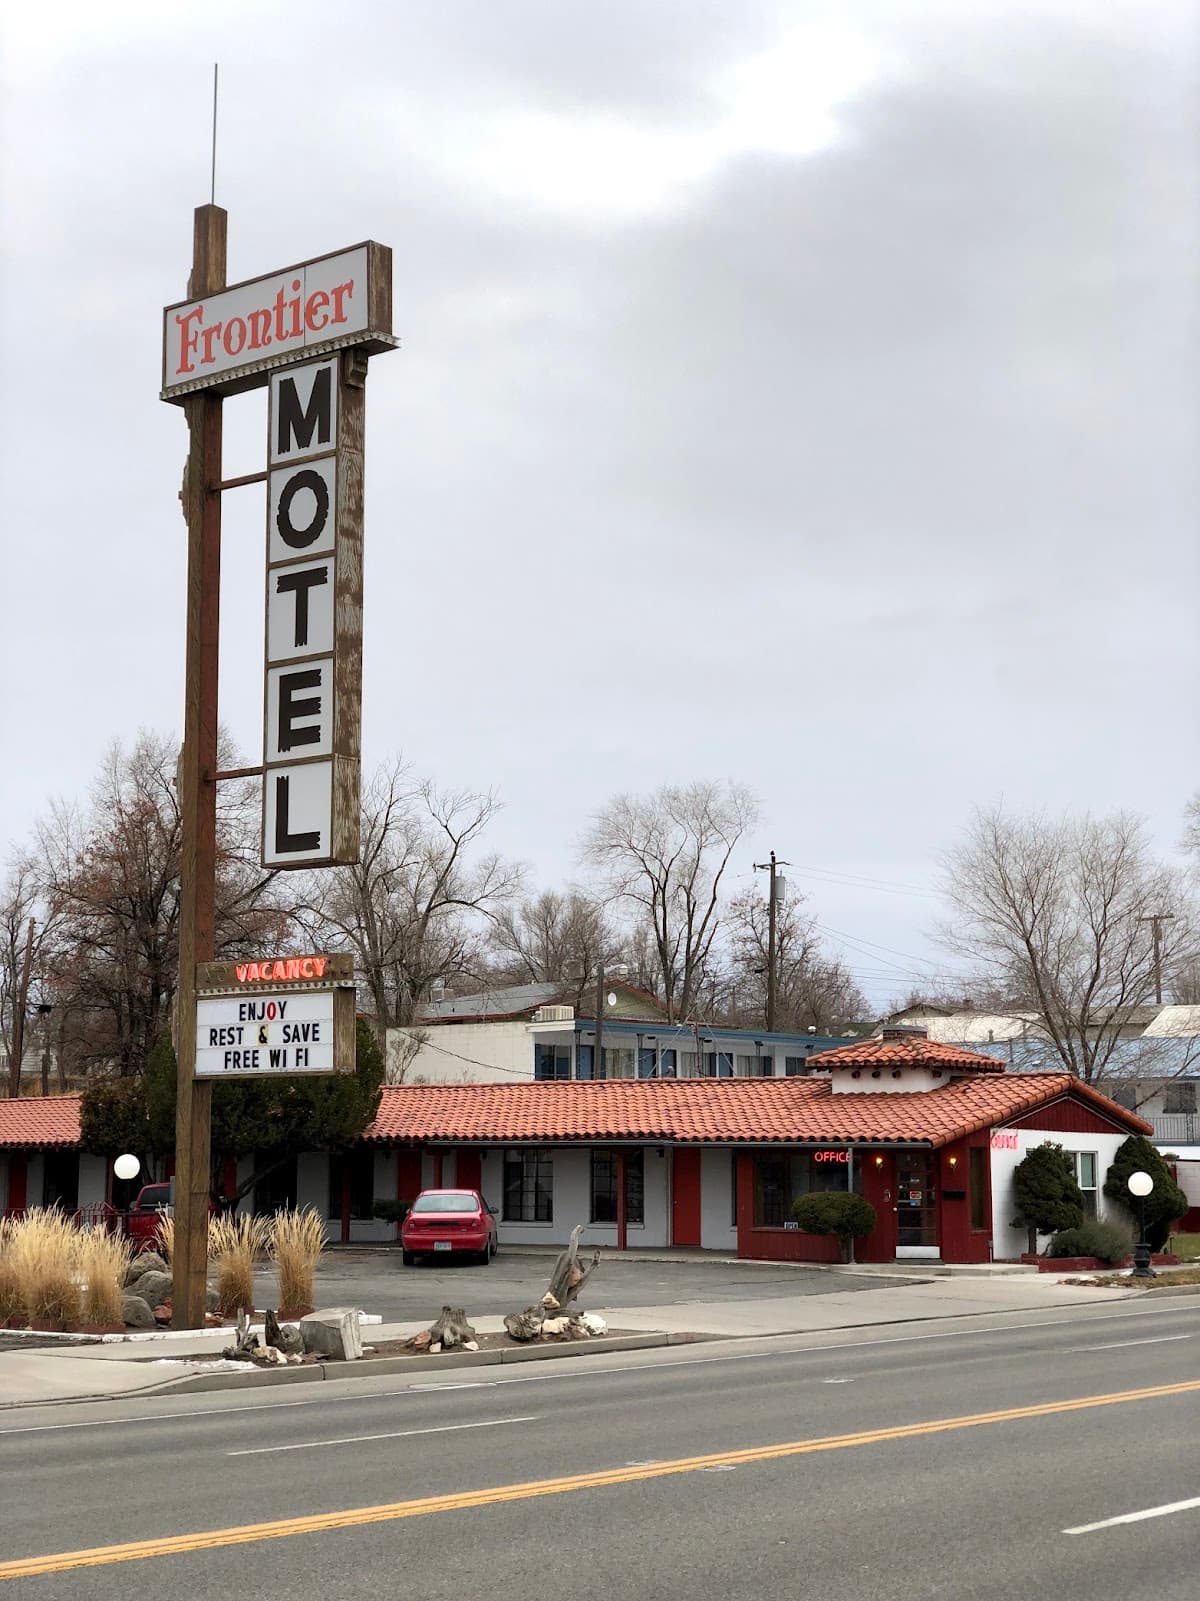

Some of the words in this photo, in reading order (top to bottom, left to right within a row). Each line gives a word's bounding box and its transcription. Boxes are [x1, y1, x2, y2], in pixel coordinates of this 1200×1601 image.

[175, 279, 354, 375] Frontier
[276, 366, 329, 854] MOTEL
[235, 957, 328, 983] VACANCY
[239, 1001, 287, 1021] ENJOY
[209, 1027, 244, 1046] REST
[258, 1025, 268, 1044] &
[282, 1023, 320, 1044] SAVE
[224, 1049, 259, 1070] FREE
[269, 1049, 287, 1068] WI
[295, 1048, 309, 1067] FI
